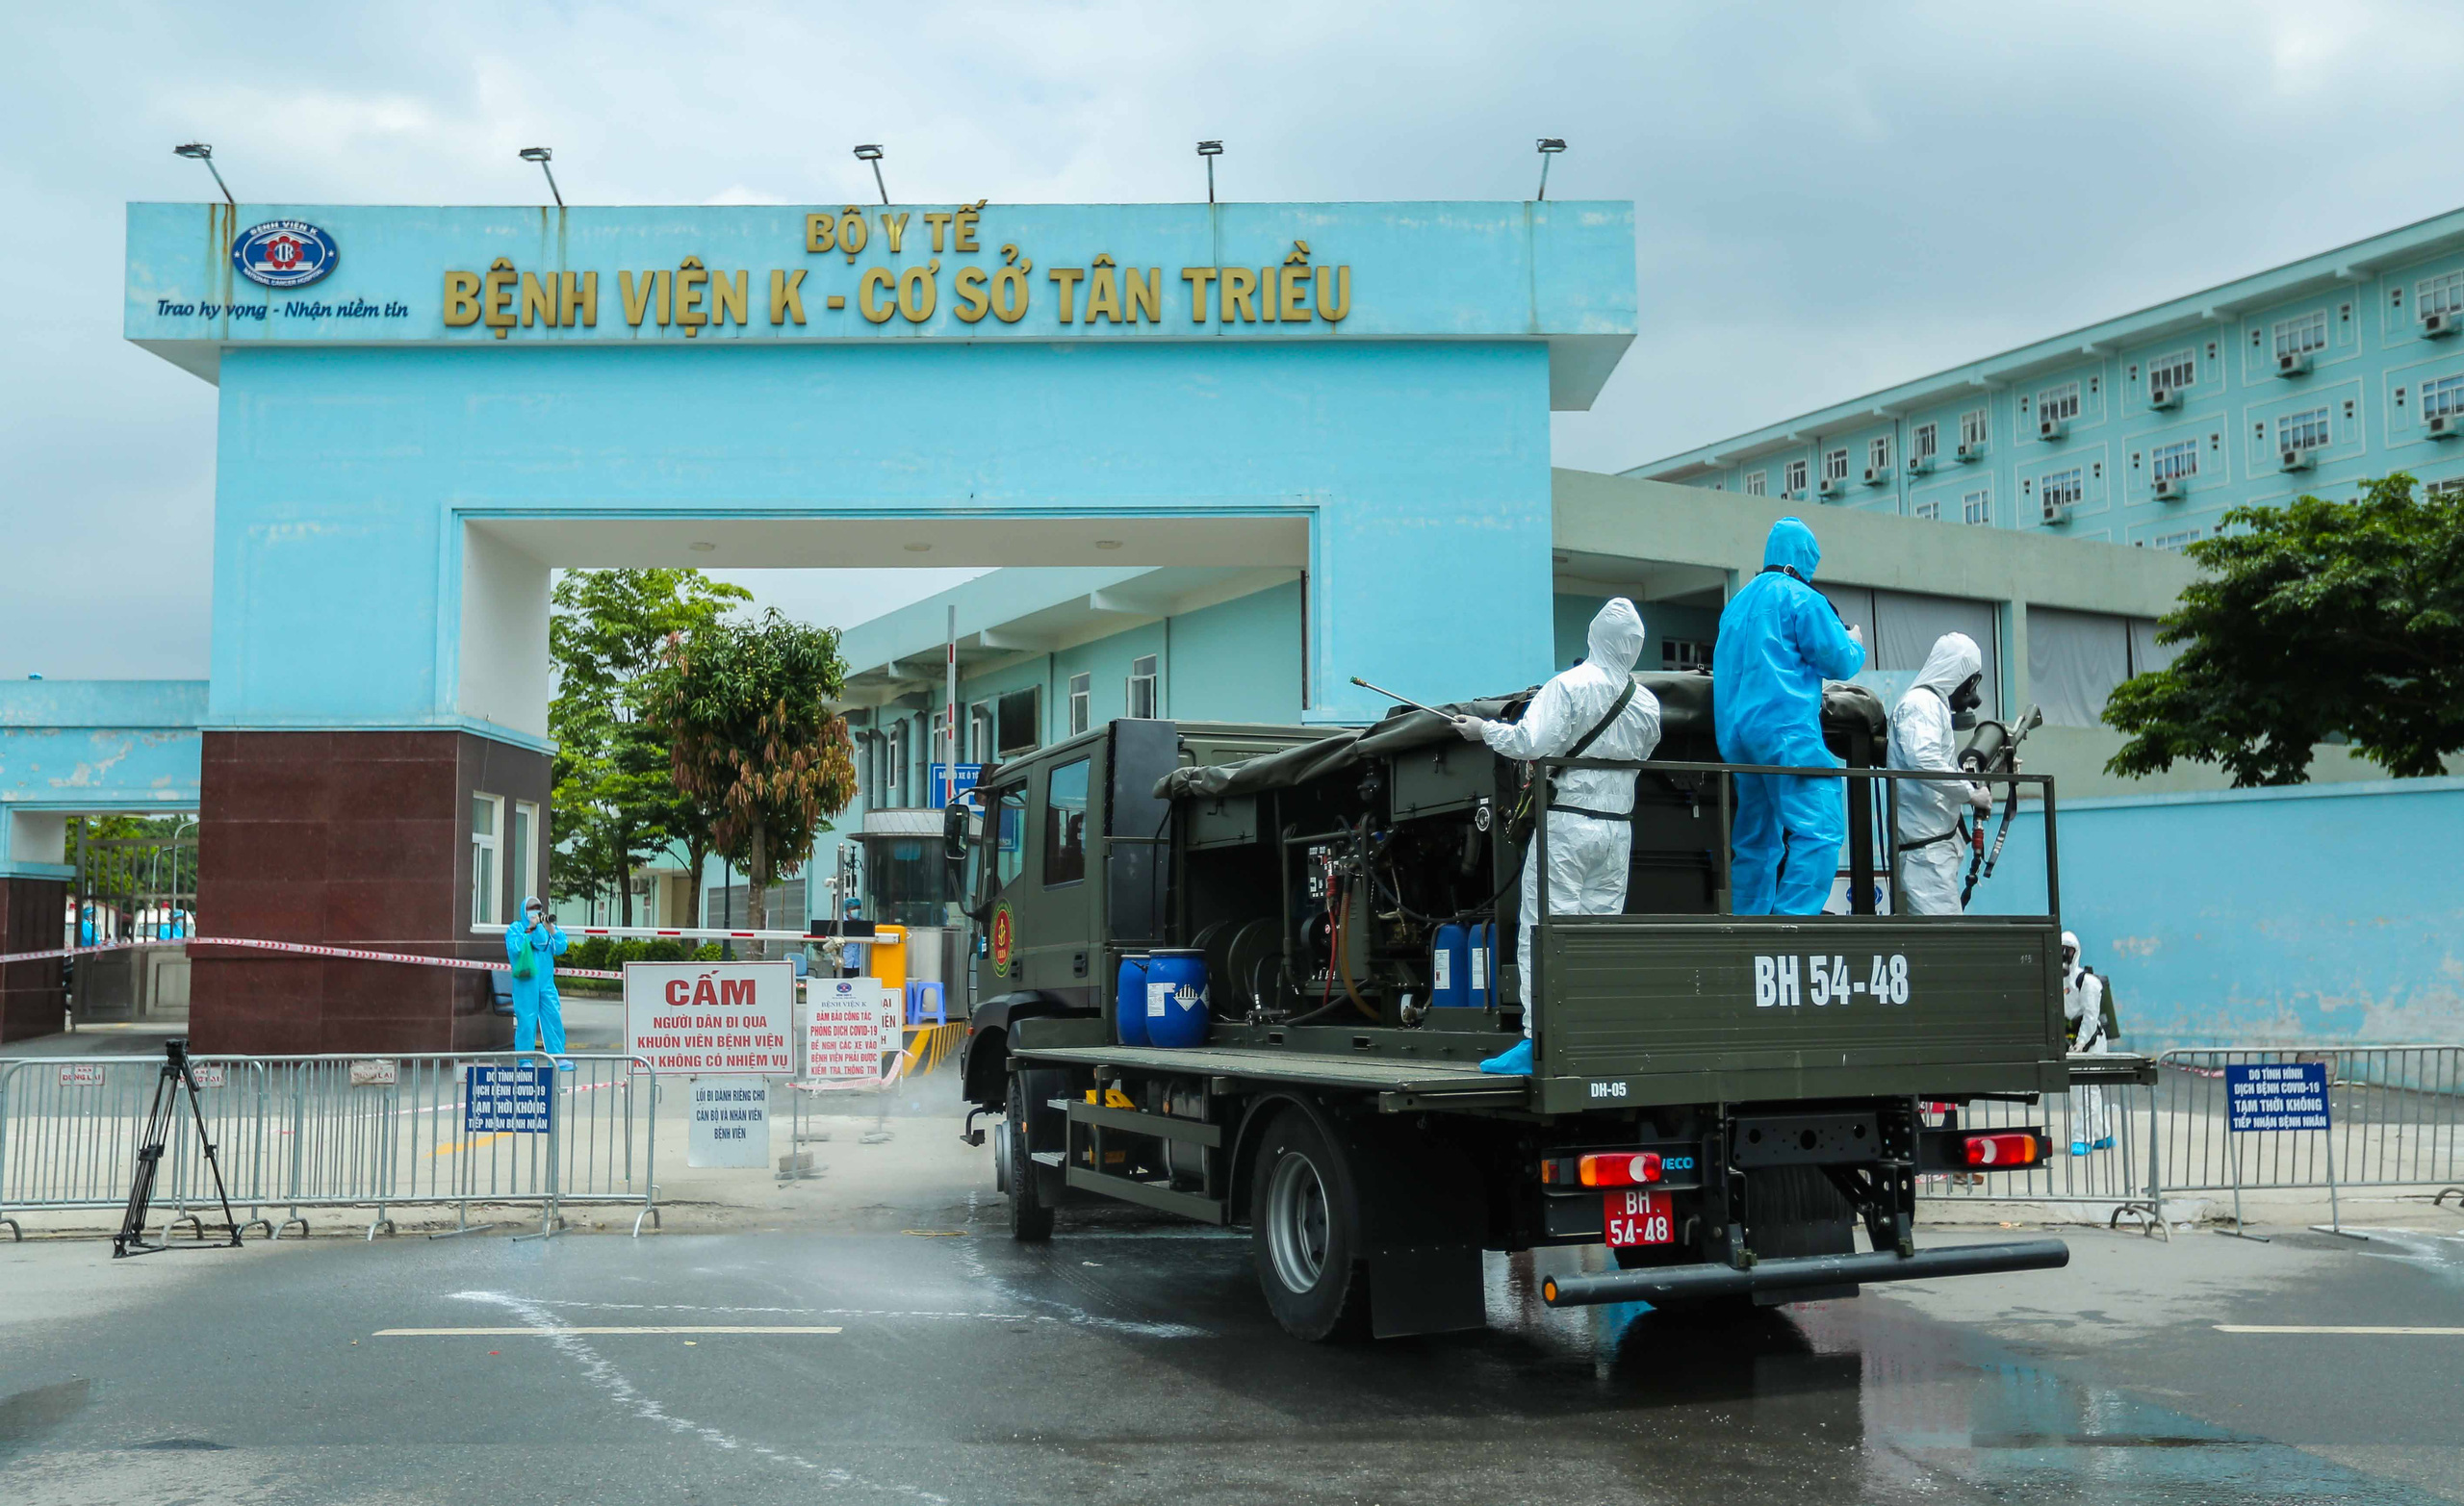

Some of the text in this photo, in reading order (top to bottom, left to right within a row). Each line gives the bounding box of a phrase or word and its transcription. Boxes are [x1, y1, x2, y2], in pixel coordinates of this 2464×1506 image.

[806, 198, 988, 264] BỘ Y TẾ
[443, 240, 1350, 339] BỆNH VIỆN K - CƠ SỞ TÂN TRIỀU
[157, 299, 194, 317] Trao
[198, 300, 221, 320] hy
[226, 303, 268, 320] vọng
[284, 300, 332, 320] Nhận
[338, 297, 380, 318] niềm
[665, 970, 757, 1007] CẤM
[1754, 954, 1910, 1008] BH 54-48
[821, 1000, 841, 1008] BỆNH
[843, 1000, 860, 1008] VIỆN
[654, 1013, 767, 1030] NGƯỜI DÂN ĐI QUA
[844, 1010, 860, 1021] CÔNG
[861, 1009, 872, 1021] TÁC
[810, 1023, 878, 1038] PHÒNG DỊCH COVID-19
[637, 1033, 783, 1050] KHUÔN VIÊN BỆNH VIỆN
[855, 1040, 862, 1050] XE
[658, 1054, 702, 1068] KHÔNG
[706, 1053, 722, 1067] CÓ
[727, 1052, 768, 1069] NHIỆM
[772, 1055, 788, 1069] VỤ
[811, 1052, 828, 1064] BỆNH
[498, 1069, 514, 1083] TÌNH
[830, 1065, 841, 1075] TRA
[844, 1064, 864, 1075] THÔNG
[867, 1065, 878, 1075] TIN
[2248, 1069, 2261, 1081] DO
[2262, 1066, 2282, 1081] TÌNH
[732, 1087, 751, 1102] RIÊNG
[753, 1089, 765, 1101] CHO
[1590, 1082, 1627, 1098] DH-05
[2234, 1080, 2321, 1096] DỊCH BỆNH COVID-19
[2234, 1096, 2323, 1114] TẠM THỜI KHÔNG
[696, 1107, 762, 1123] CÁN BỘ VÀ NHÂN VIÊN
[2233, 1112, 2327, 1130] TIẾP NHẬN BỆNH NHÂN
[714, 1125, 746, 1142] BỆNH VIỆN
[1626, 1190, 1651, 1215] BH
[1610, 1216, 1668, 1245] 54-48
